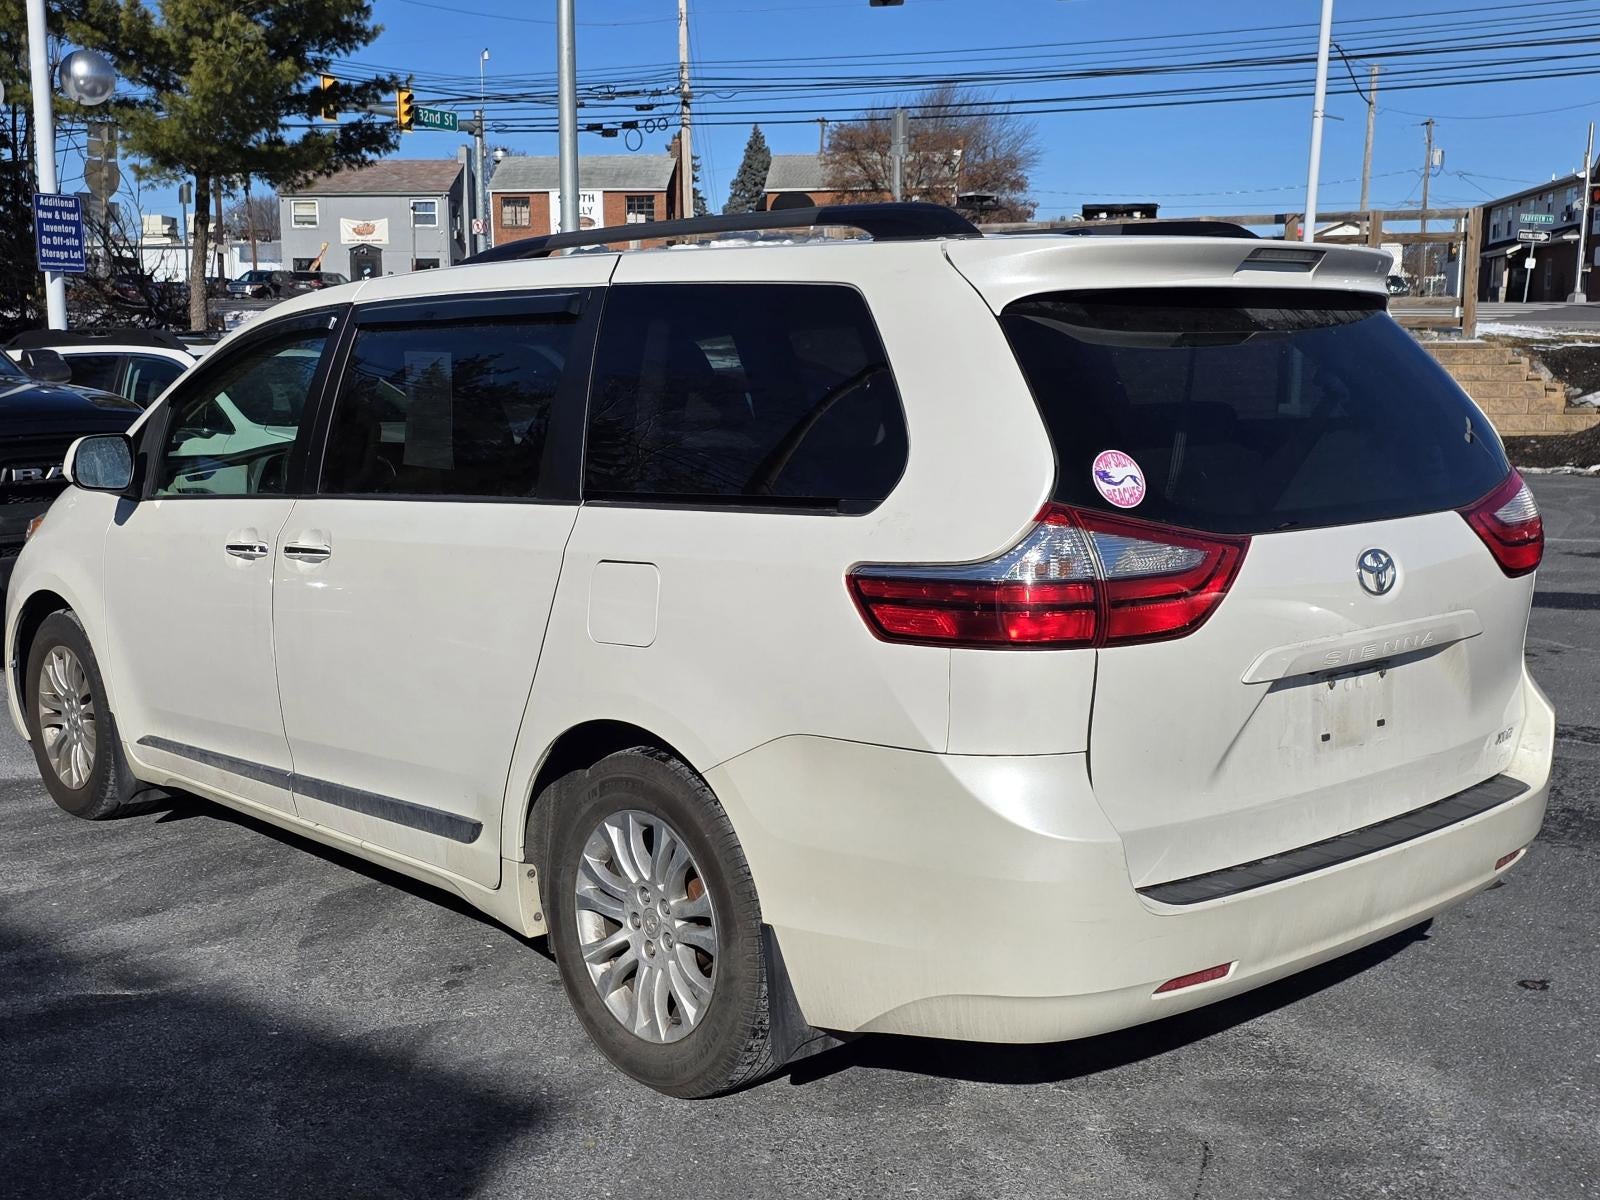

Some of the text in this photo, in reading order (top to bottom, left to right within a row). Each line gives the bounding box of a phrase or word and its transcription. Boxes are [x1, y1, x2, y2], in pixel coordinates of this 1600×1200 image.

[419, 109, 453, 126] 32nd St
[40, 196, 75, 208] Additional
[38, 209, 79, 221] New & Used
[43, 222, 76, 235] Inventory
[41, 235, 79, 246] On Off-site
[41, 248, 81, 260] Storage Lot
[1324, 631, 1433, 665] SIENNA
